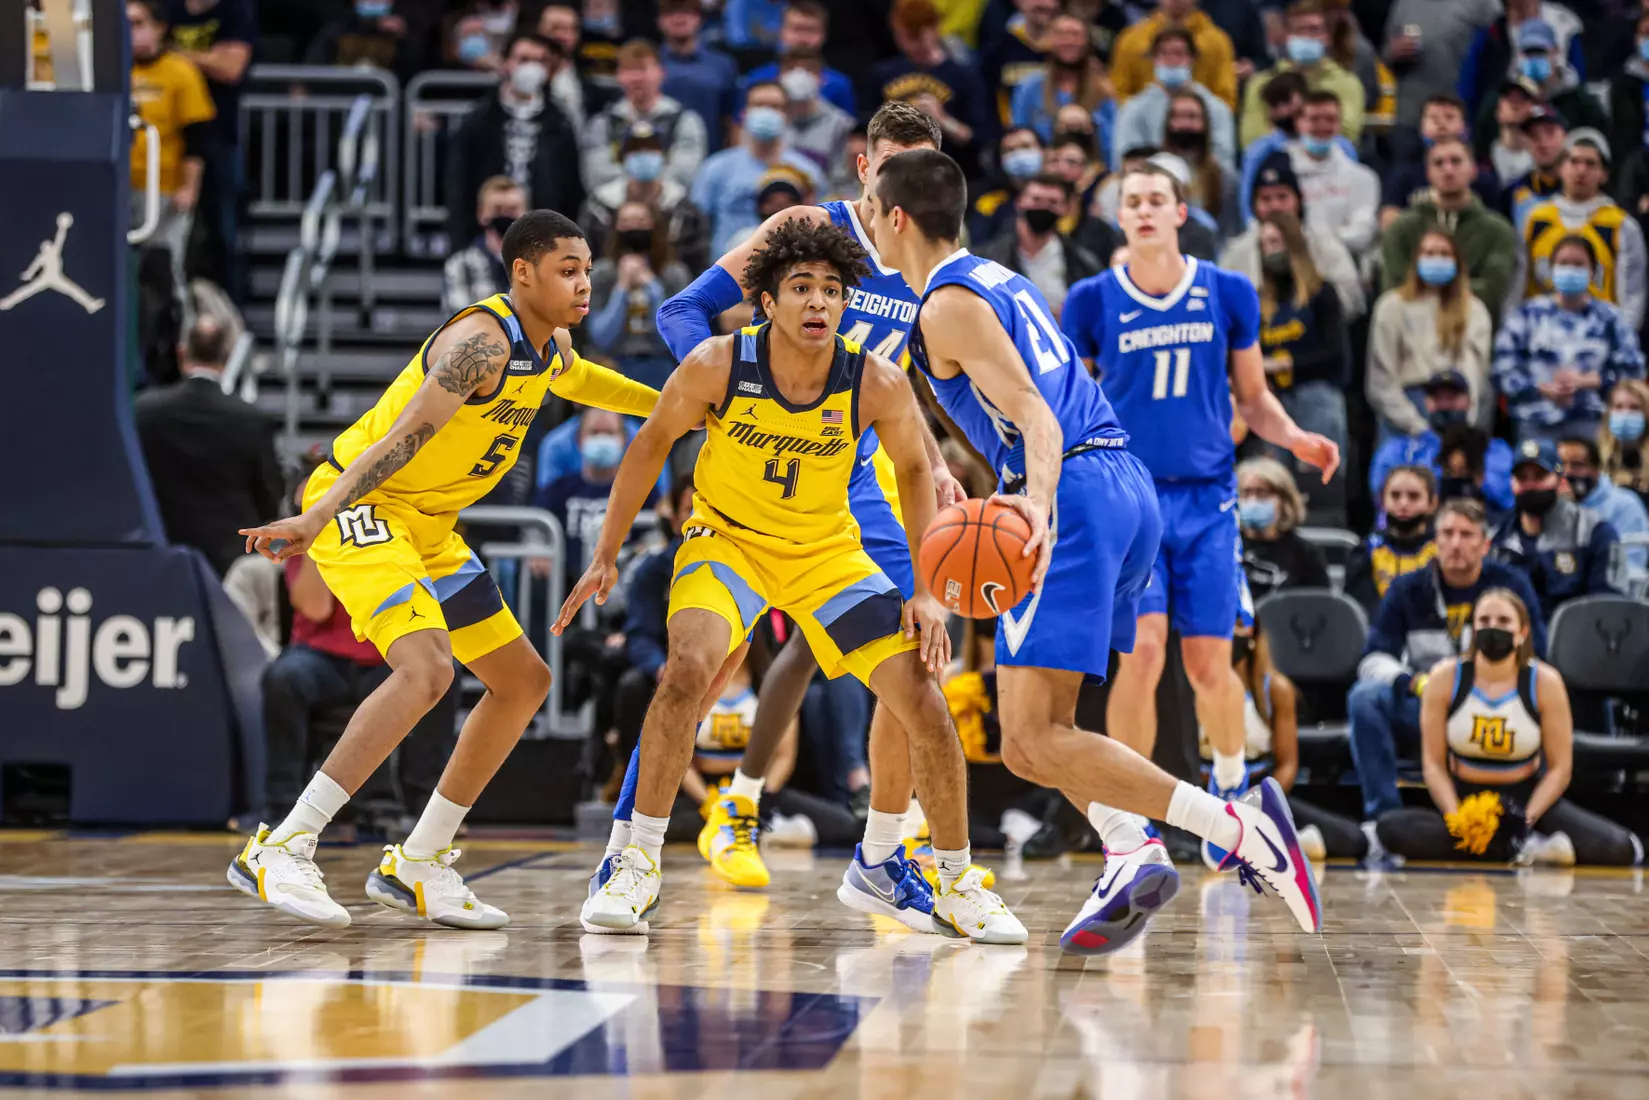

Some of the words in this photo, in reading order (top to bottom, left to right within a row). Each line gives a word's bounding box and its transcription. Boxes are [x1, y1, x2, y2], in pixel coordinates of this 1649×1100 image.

[1013, 289, 1071, 375] 21
[1118, 322, 1214, 353] CREIGHTON
[1152, 348, 1191, 399] 11
[468, 433, 519, 477] 5
[727, 420, 850, 457] Marquette
[763, 458, 800, 499] 4
[335, 504, 394, 548] MU
[0, 586, 195, 710] eijer
[1470, 714, 1516, 754] MU
